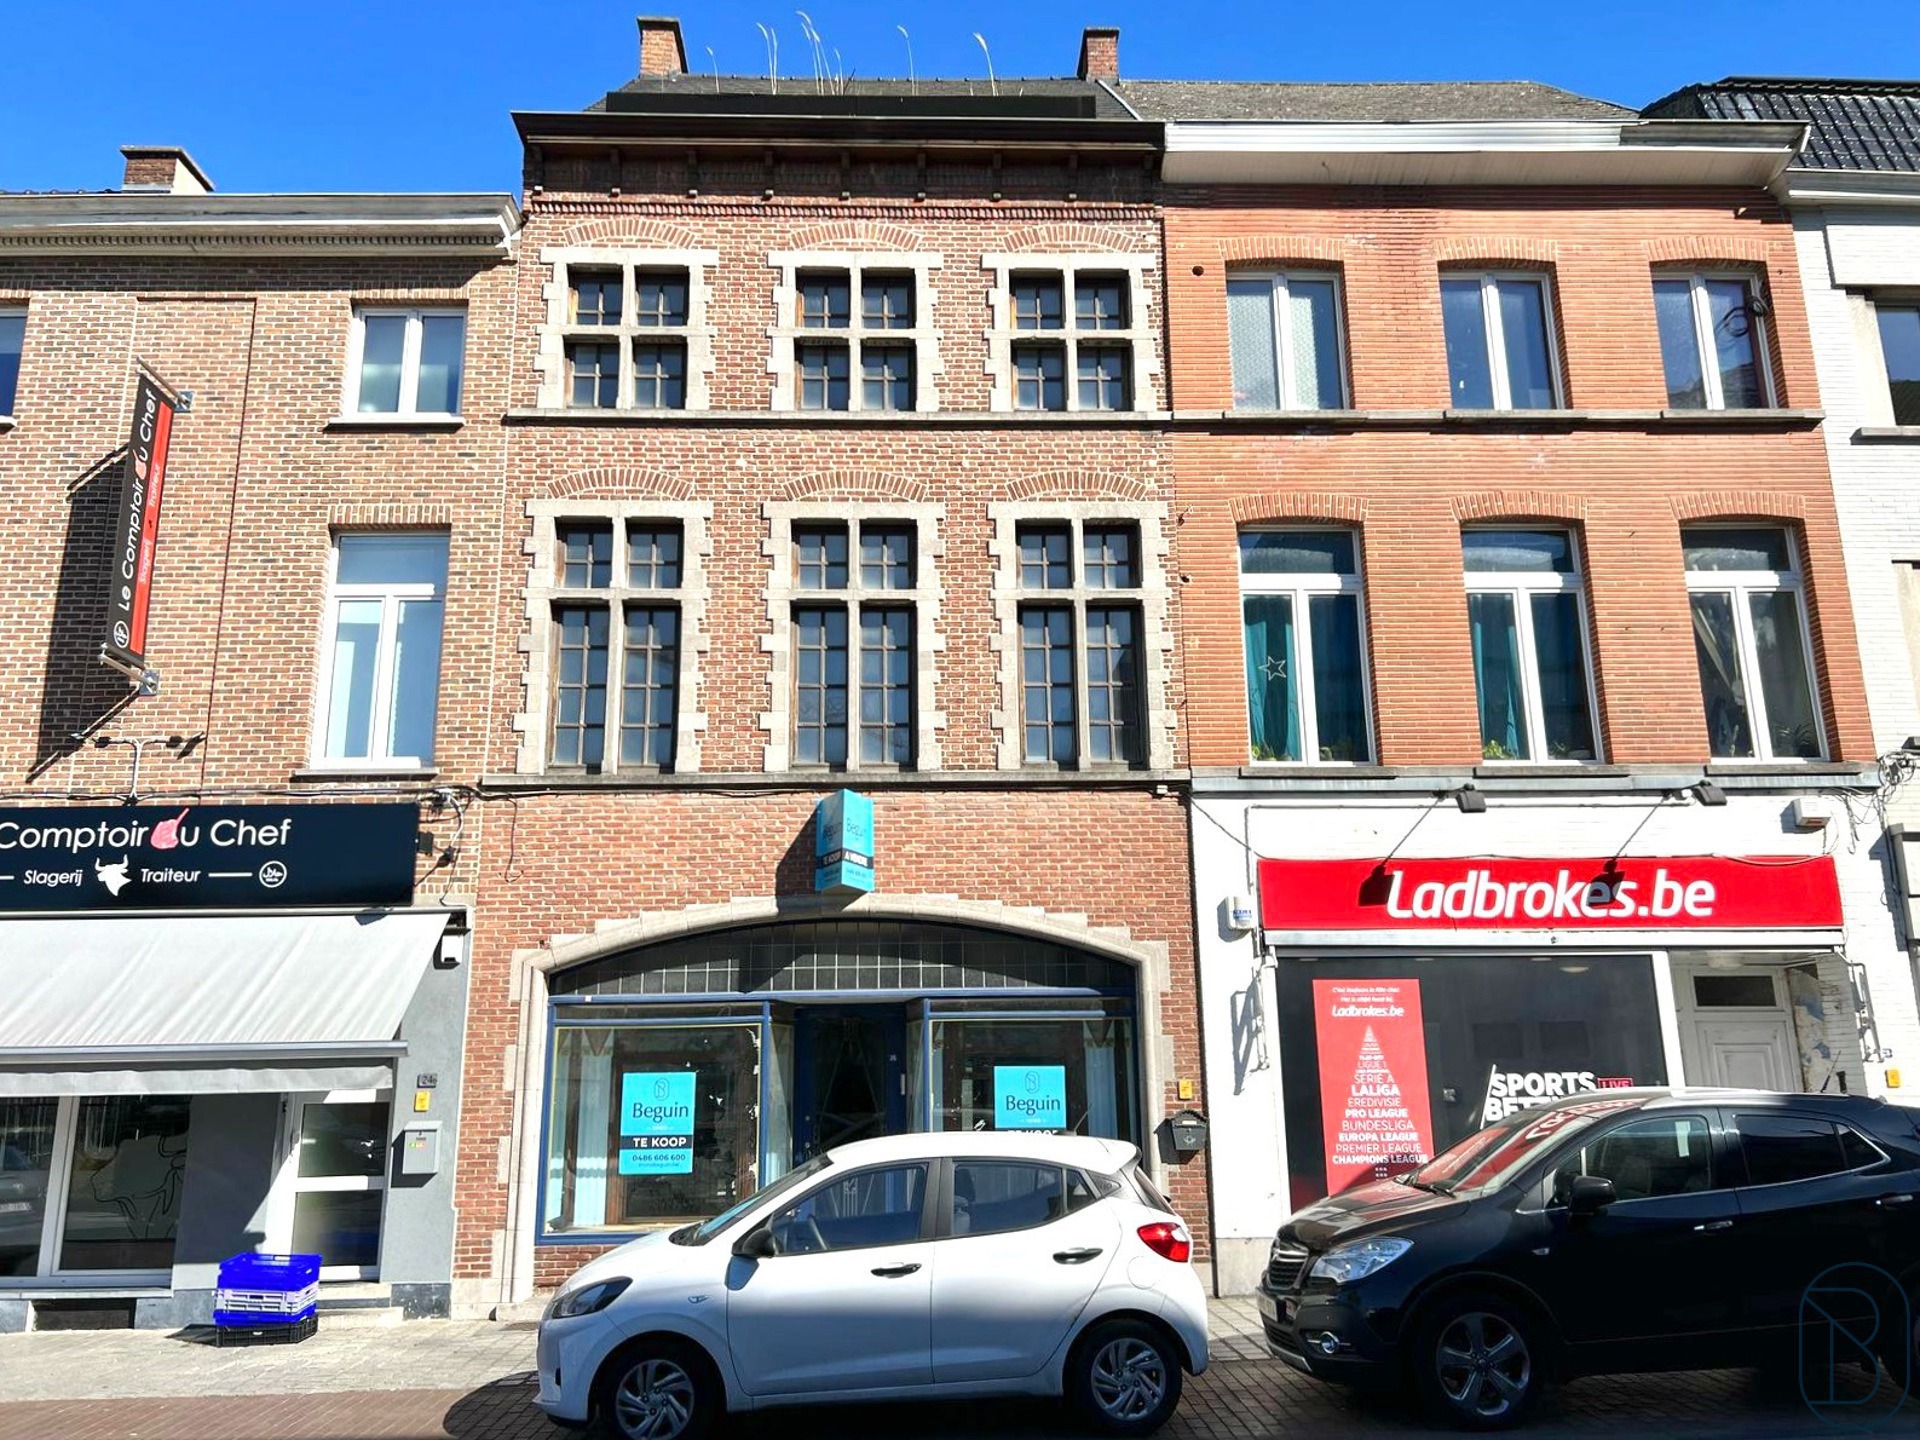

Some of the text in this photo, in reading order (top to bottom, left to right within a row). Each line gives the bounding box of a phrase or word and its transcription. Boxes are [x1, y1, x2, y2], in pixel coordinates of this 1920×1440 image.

[140, 388, 157, 443] Chef
[122, 478, 145, 580] Comptoir
[119, 586, 130, 611] Le
[0, 820, 149, 853] Comptoir
[210, 819, 292, 847] Chef
[23, 867, 202, 888] Slagerij Traiteur
[1386, 868, 1716, 919] Ladbrokes.be
[1354, 1074, 1396, 1084] SERIE A
[1490, 1072, 1597, 1097] SPORTS
[1351, 1084, 1401, 1097] LALIGA
[1005, 1094, 1061, 1116] Beguin
[1347, 1097, 1402, 1107] EREDIVISIE
[633, 1102, 688, 1122] Beguin
[1344, 1108, 1409, 1119] PRO LEAGUE
[1342, 1119, 1415, 1131] BUNDESLIGA
[632, 1136, 687, 1148] TE KOOP
[1338, 1131, 1419, 1142] EUROPA LEAGUE
[1335, 1143, 1423, 1154] PREMIER LEAGUE
[654, 1153, 670, 1161] 606
[670, 1153, 686, 1161] 600
[1331, 1153, 1429, 1165] CHAMPIONS LEAGUE
